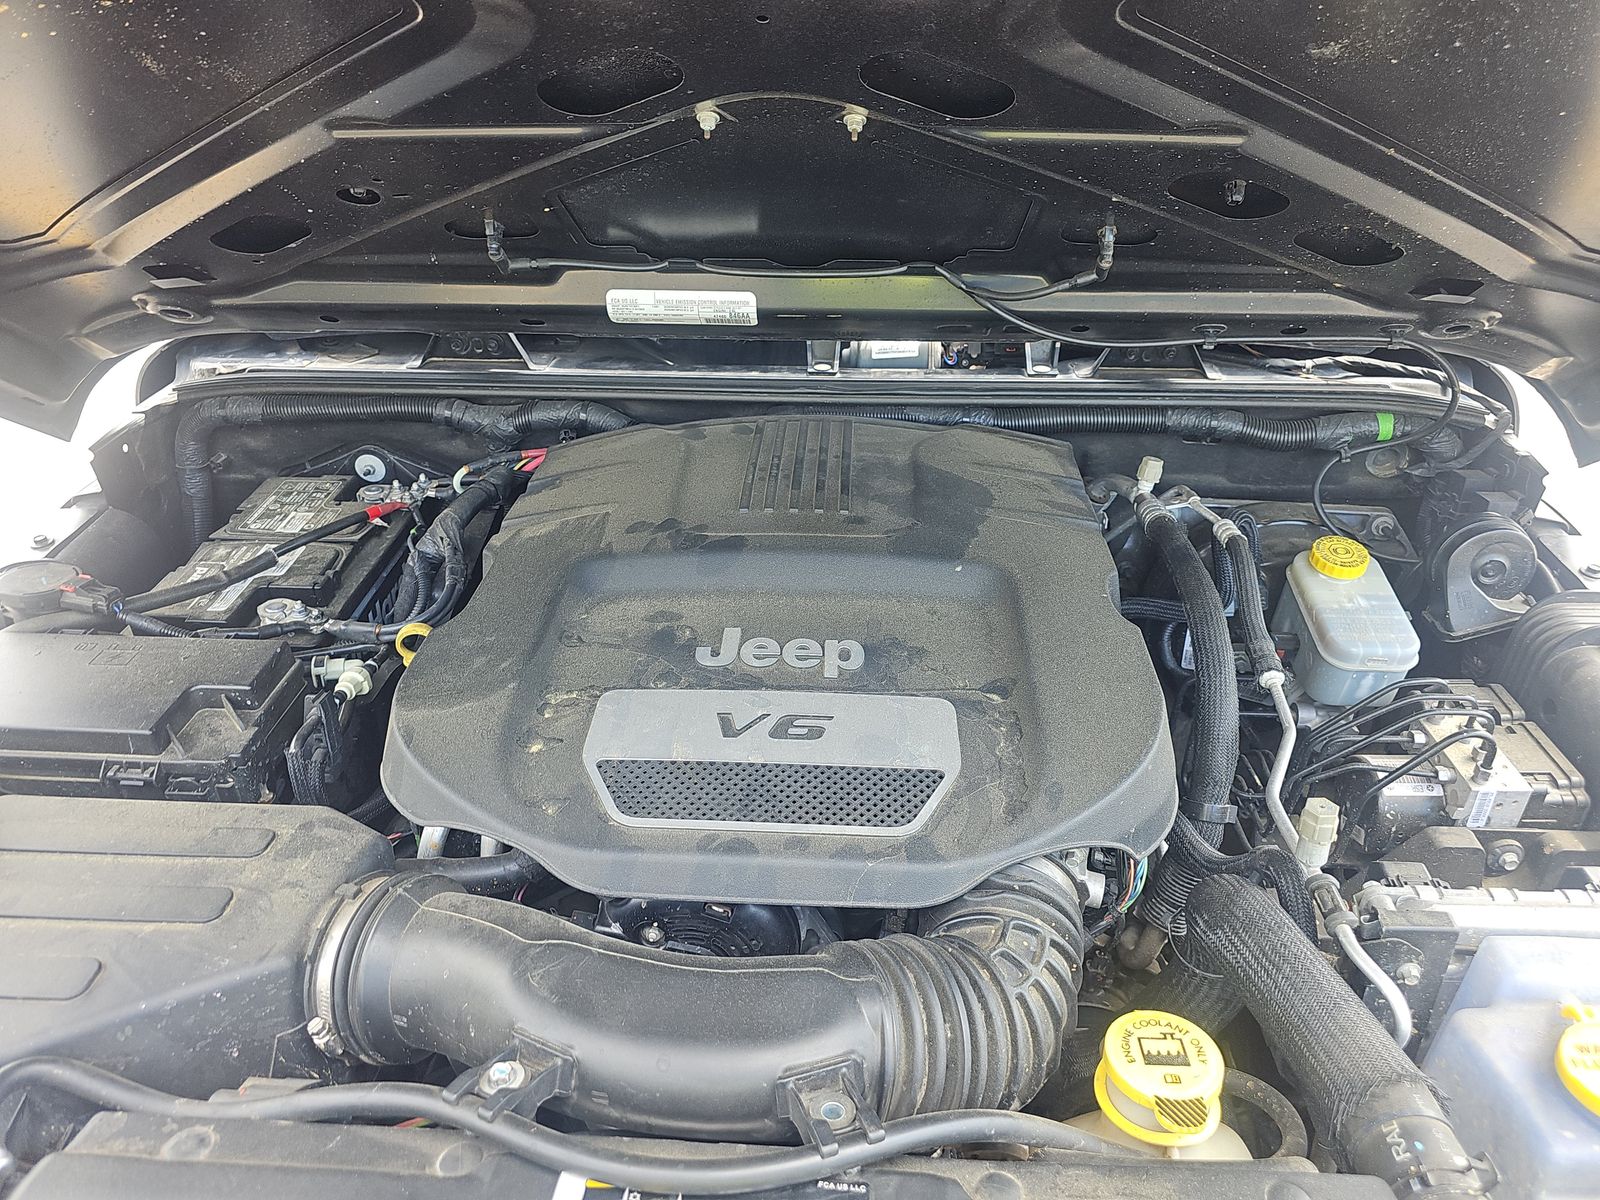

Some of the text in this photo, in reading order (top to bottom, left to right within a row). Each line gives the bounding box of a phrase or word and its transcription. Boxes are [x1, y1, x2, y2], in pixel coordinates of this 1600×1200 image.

[695, 627, 865, 679] Jeep
[716, 712, 835, 741] V6
[1121, 1019, 1208, 1065] ENGINE COOLANT ONLY
[816, 1180, 867, 1194] FCA US LLC
